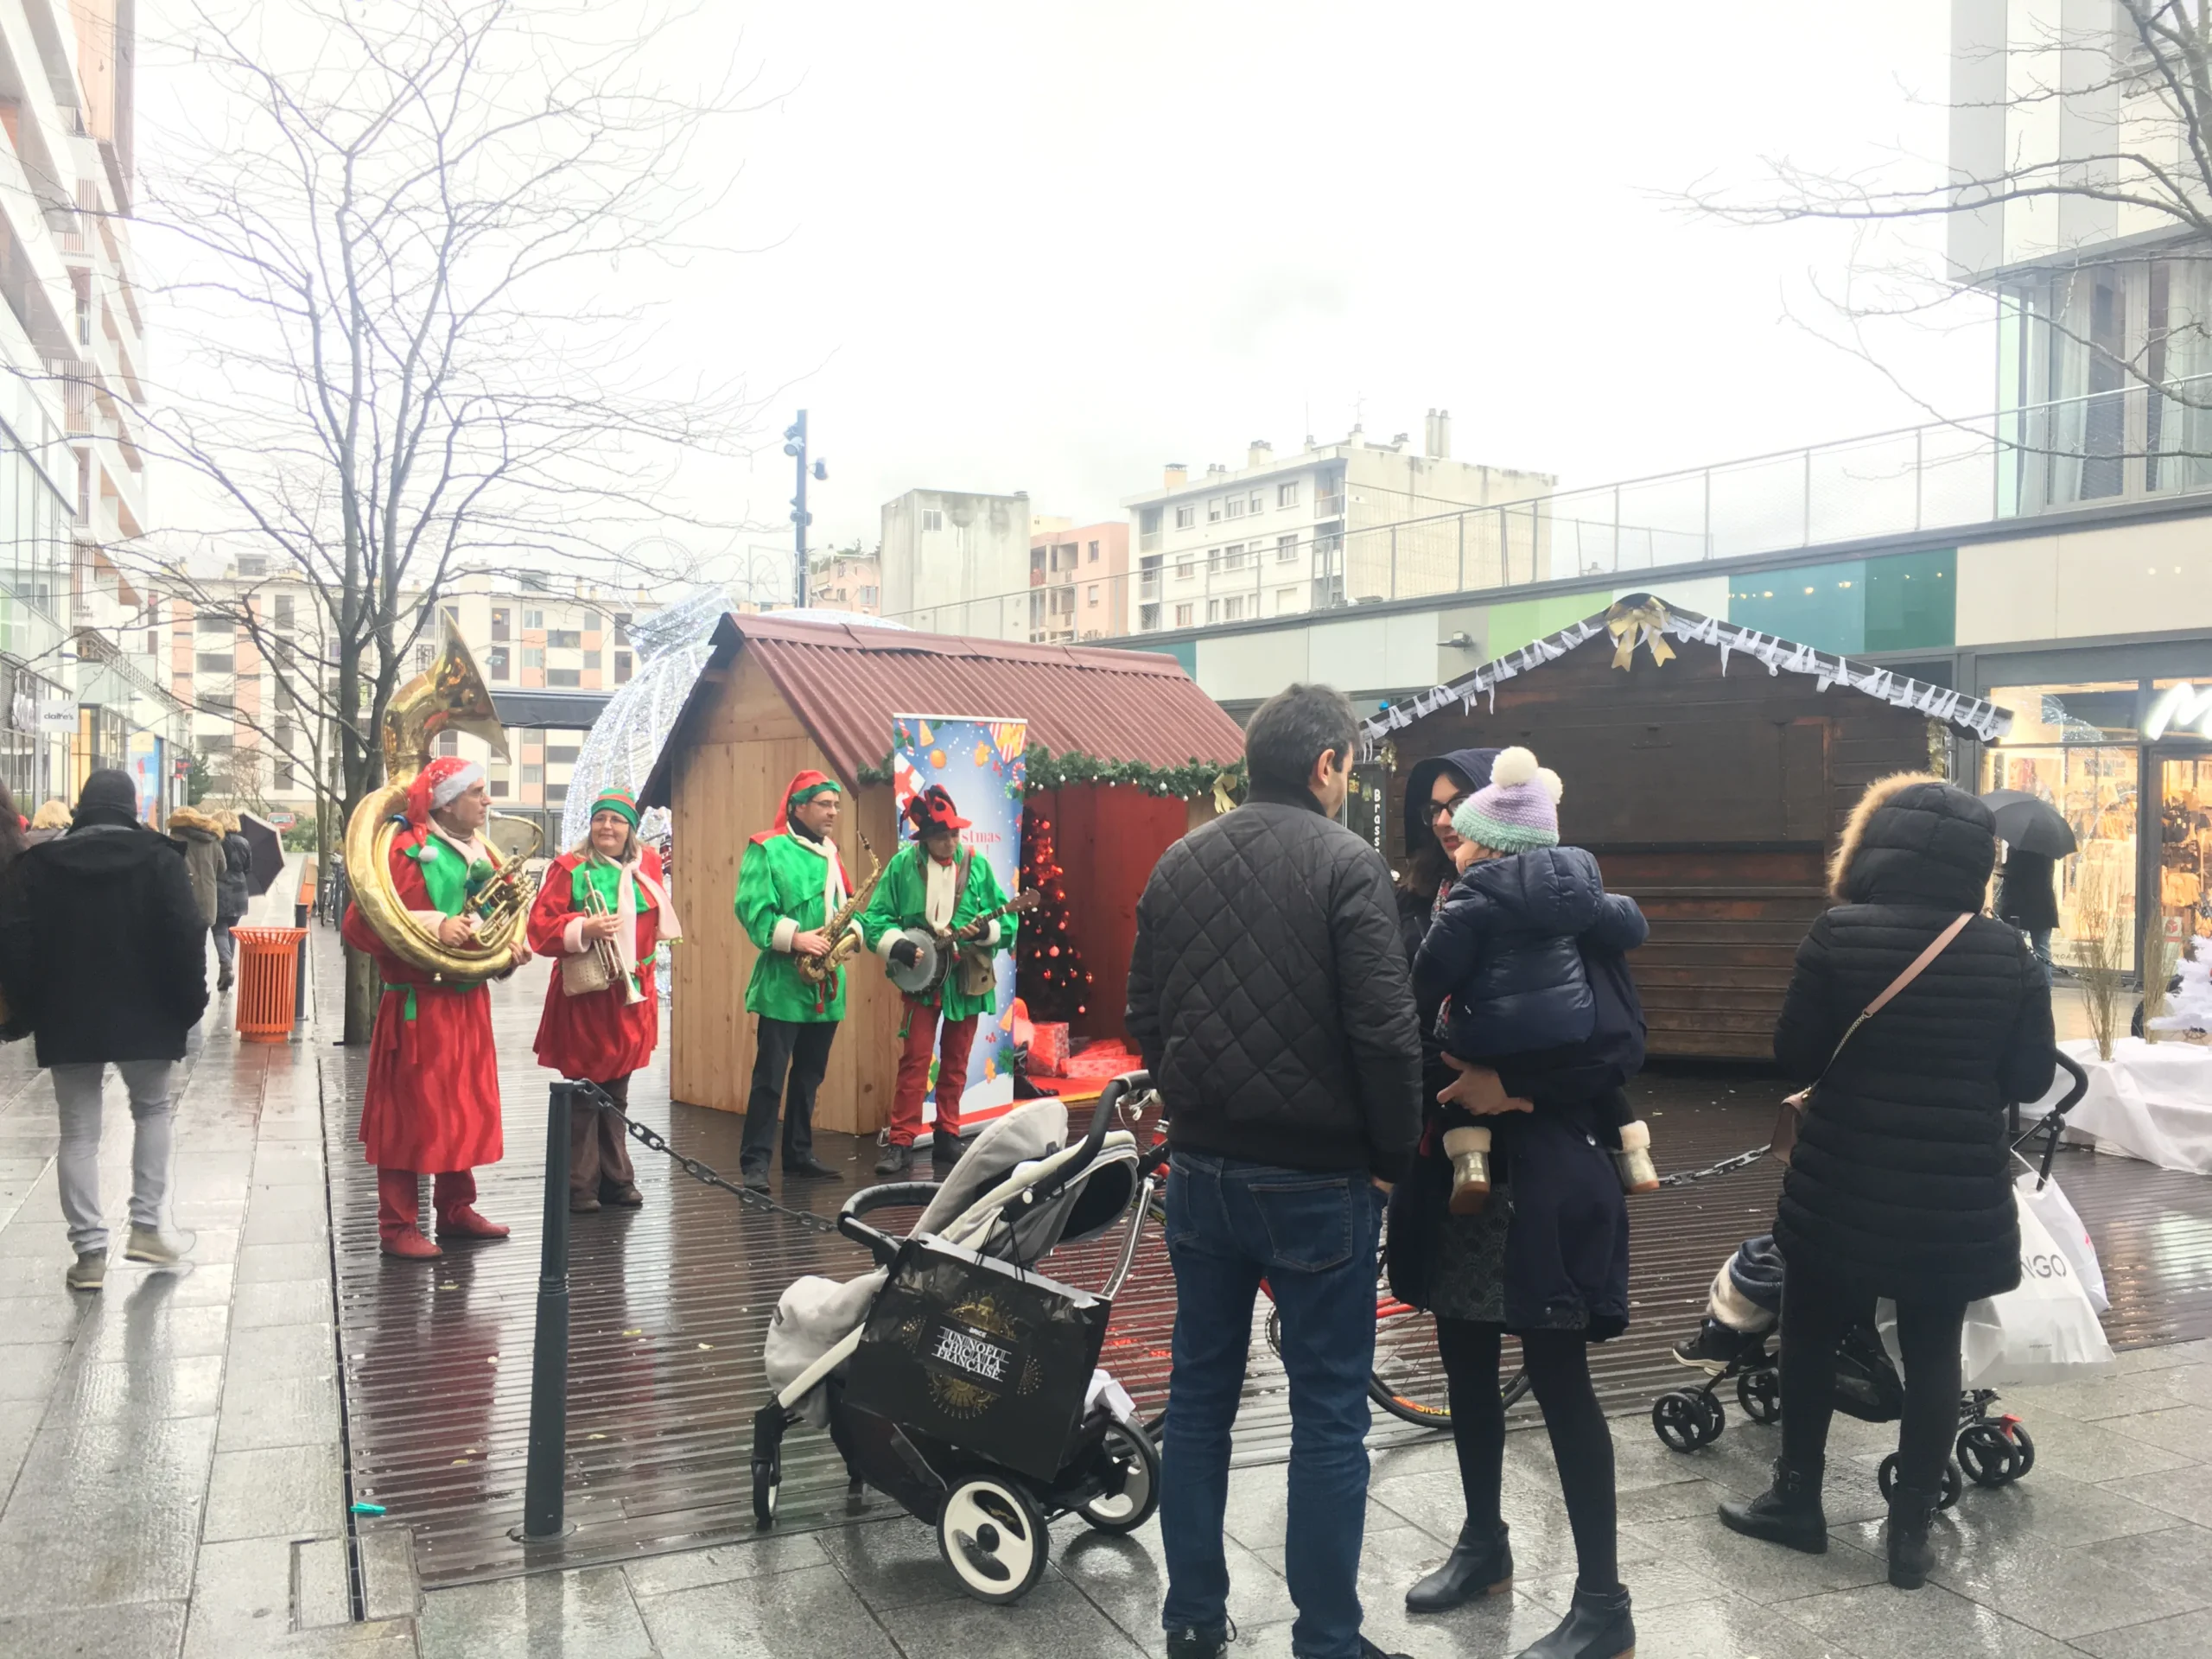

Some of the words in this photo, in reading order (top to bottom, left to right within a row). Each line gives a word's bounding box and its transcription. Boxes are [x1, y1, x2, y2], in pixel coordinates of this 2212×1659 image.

[962, 830, 1001, 843] stmas
[2021, 1254, 2067, 1280] NGO
[948, 1331, 965, 1346] UN
[937, 1347, 1001, 1380] FRANÇAISE
[942, 1339, 971, 1359] CHIC
[985, 1355, 1001, 1371] LA
